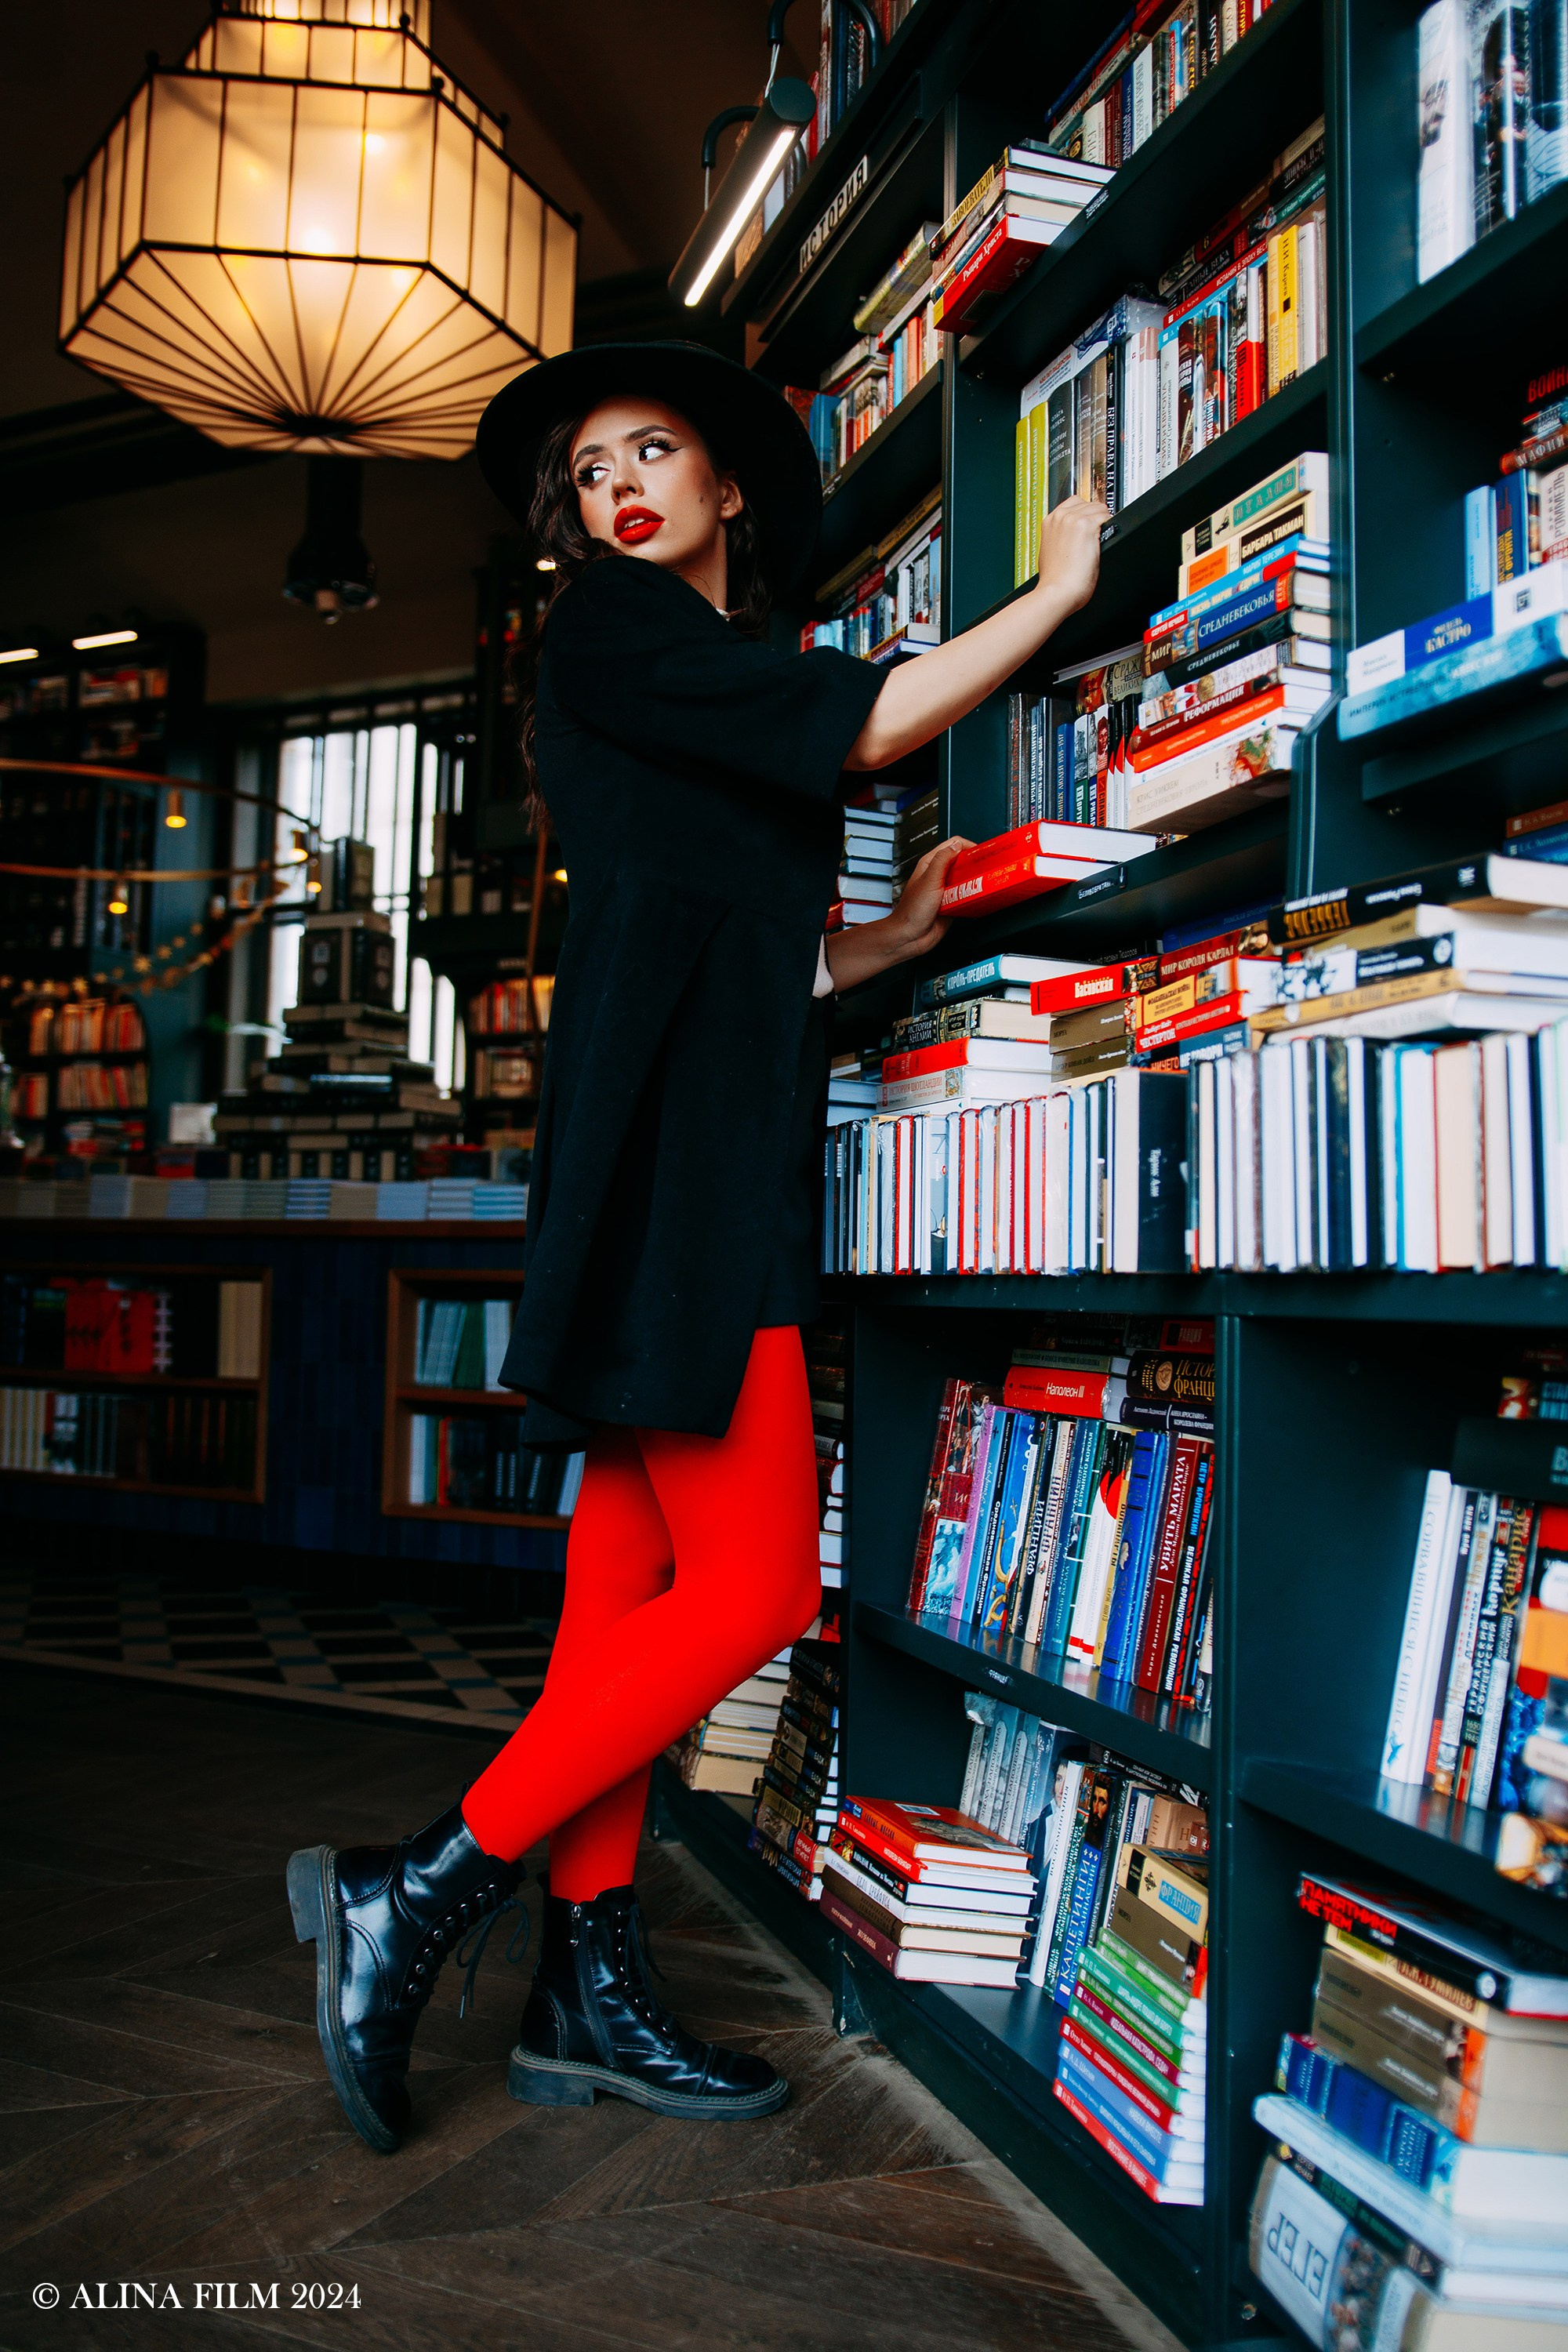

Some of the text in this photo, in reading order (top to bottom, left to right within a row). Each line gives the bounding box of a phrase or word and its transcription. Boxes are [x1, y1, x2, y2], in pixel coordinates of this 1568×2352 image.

[800, 157, 867, 273] ИСТОРИЯ
[963, 228, 1003, 281] Рыцари Христа
[1106, 406, 1116, 428] БЕЗ
[1106, 430, 1116, 469] ПРАВА
[1515, 434, 1565, 467] МАФИЯ
[1106, 470, 1116, 488] НА
[1554, 471, 1566, 538] РОММЕЛЬ
[1242, 514, 1304, 559] БАРБАРА ТАКМАН
[1152, 589, 1275, 661] МИР СРЕДНЕВЕКОВЬЯ
[1425, 622, 1472, 654] КАСТРО
[1186, 639, 1240, 672] СРЕДНЕВЕКОВЬЕ
[1184, 684, 1244, 722] РЕФОРМАЦИЯ
[947, 961, 995, 990] КОРОЛЬ-ПРЕДАТЕЛЬ
[1161, 946, 1229, 976] МИР КОРОЛЯ КАРЛА
[1075, 978, 1113, 998] Басовская
[908, 1019, 932, 1033] ИСТОРИЯ
[909, 1029, 932, 1044] АНГЛИИ
[1139, 1029, 1176, 1048] ЧЕСТЕРТОН
[1180, 1053, 1191, 1067] НЕ
[1149, 1147, 1162, 1198] Тарик Али
[1176, 1359, 1215, 1377] ИСТОР
[1046, 1382, 1079, 1397] Наполеон
[1174, 1418, 1195, 1428] КОРОЛЕВА
[1077, 1432, 1093, 1507] БЕЗУМНОГО КОРОЛЯ
[1160, 1455, 1186, 1571] УБИТЬ МАРАТА
[1189, 1486, 1203, 1537] КРОПОТКИН
[1027, 1500, 1045, 1575] ФРАНЦИИ
[1111, 1503, 1127, 1567] БОНАПАРТЫ
[977, 1500, 1000, 1614] Средневековая Франция
[1501, 1506, 1526, 1615] Канарис
[1165, 1545, 1195, 1692] ВЕЛИКАЯ ФРАНЦУЗСКАЯ РЕВОЛЮЦИЯ
[1146, 1652, 1156, 1677] Борис
[1469, 1618, 1488, 1714] ГЕРМАНСКИЙ
[1477, 1619, 1497, 1715] ОФИЦЕРСКИЙ
[1080, 1864, 1097, 1928] ДИНАСТИИ
[1160, 1881, 1201, 1923] ФРАНЦИЯ
[1299, 1894, 1353, 1933] НЕ ТЕМ
[1302, 1878, 1398, 1939] ПАМЯТНИКИ
[1060, 1855, 1094, 1979] КАПЕТИНГИ
[1423, 1974, 1475, 2012] ГУМИЛЕВ
[1069, 2029, 1080, 2044] Отто
